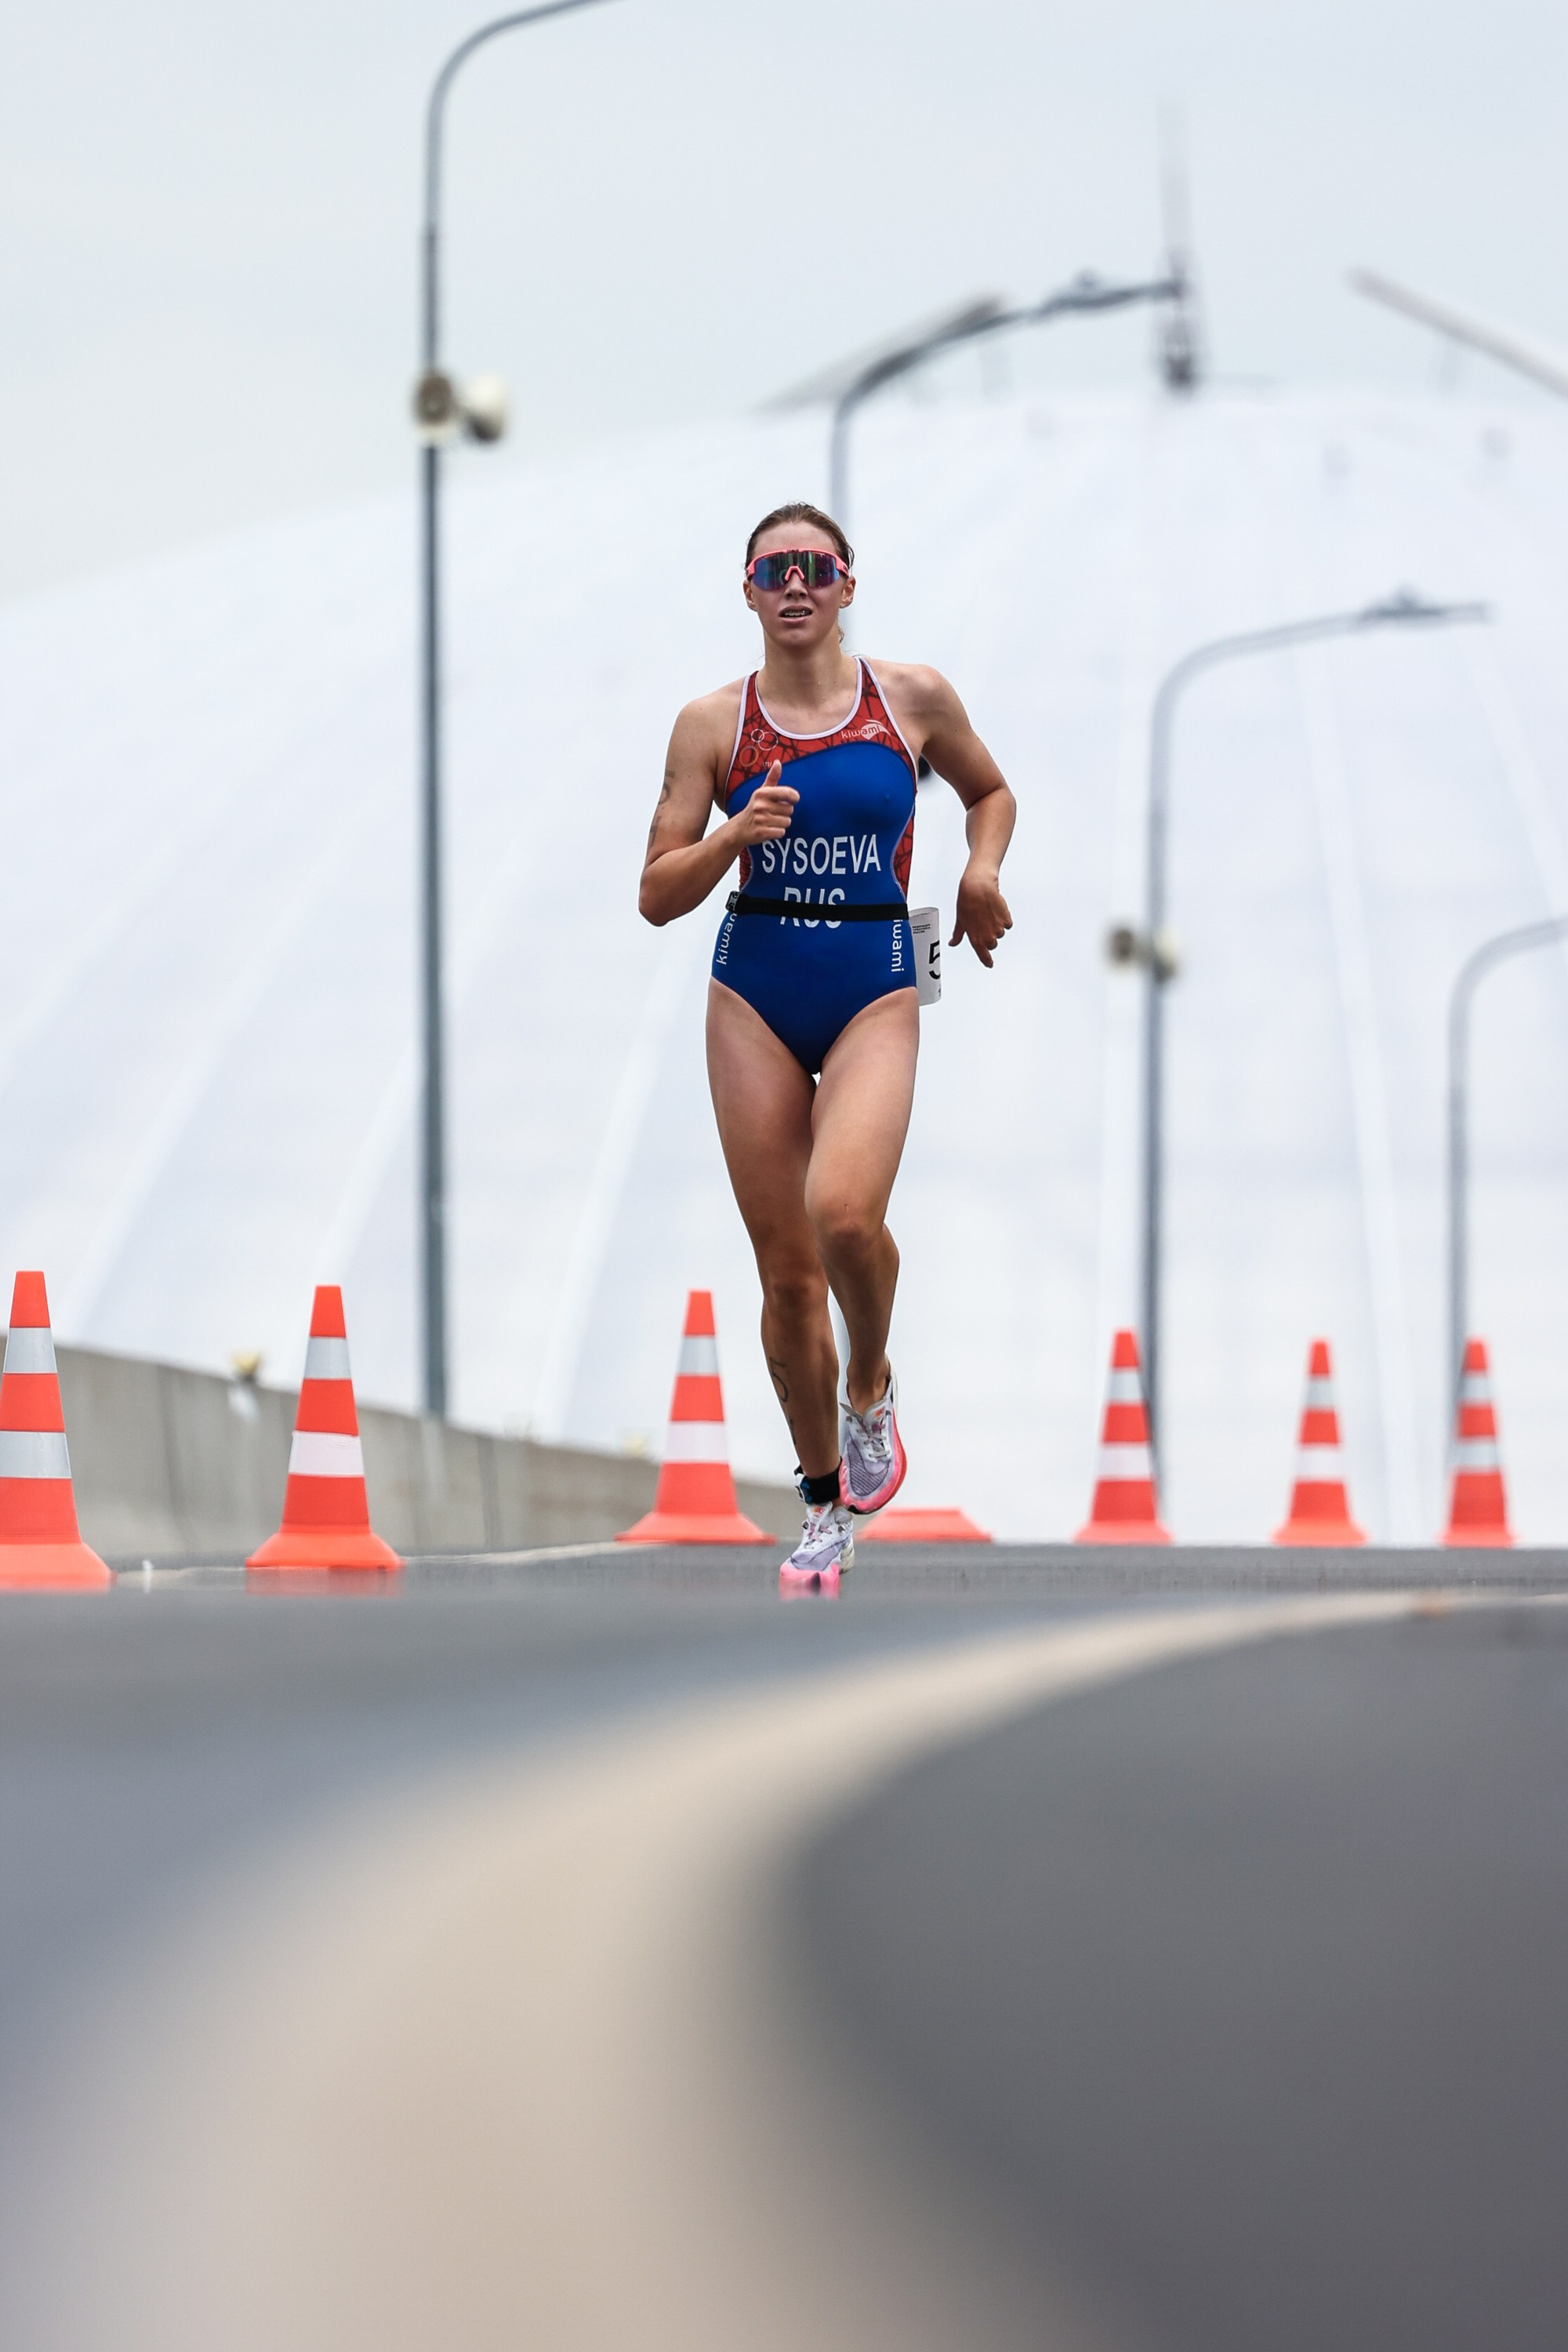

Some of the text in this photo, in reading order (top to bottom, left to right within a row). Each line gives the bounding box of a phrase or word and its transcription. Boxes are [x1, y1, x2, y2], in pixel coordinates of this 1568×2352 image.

[841, 724, 880, 739] kiwami
[761, 834, 881, 875] SYSOEVA
[780, 887, 845, 929] RUS
[891, 919, 904, 972] iwami
